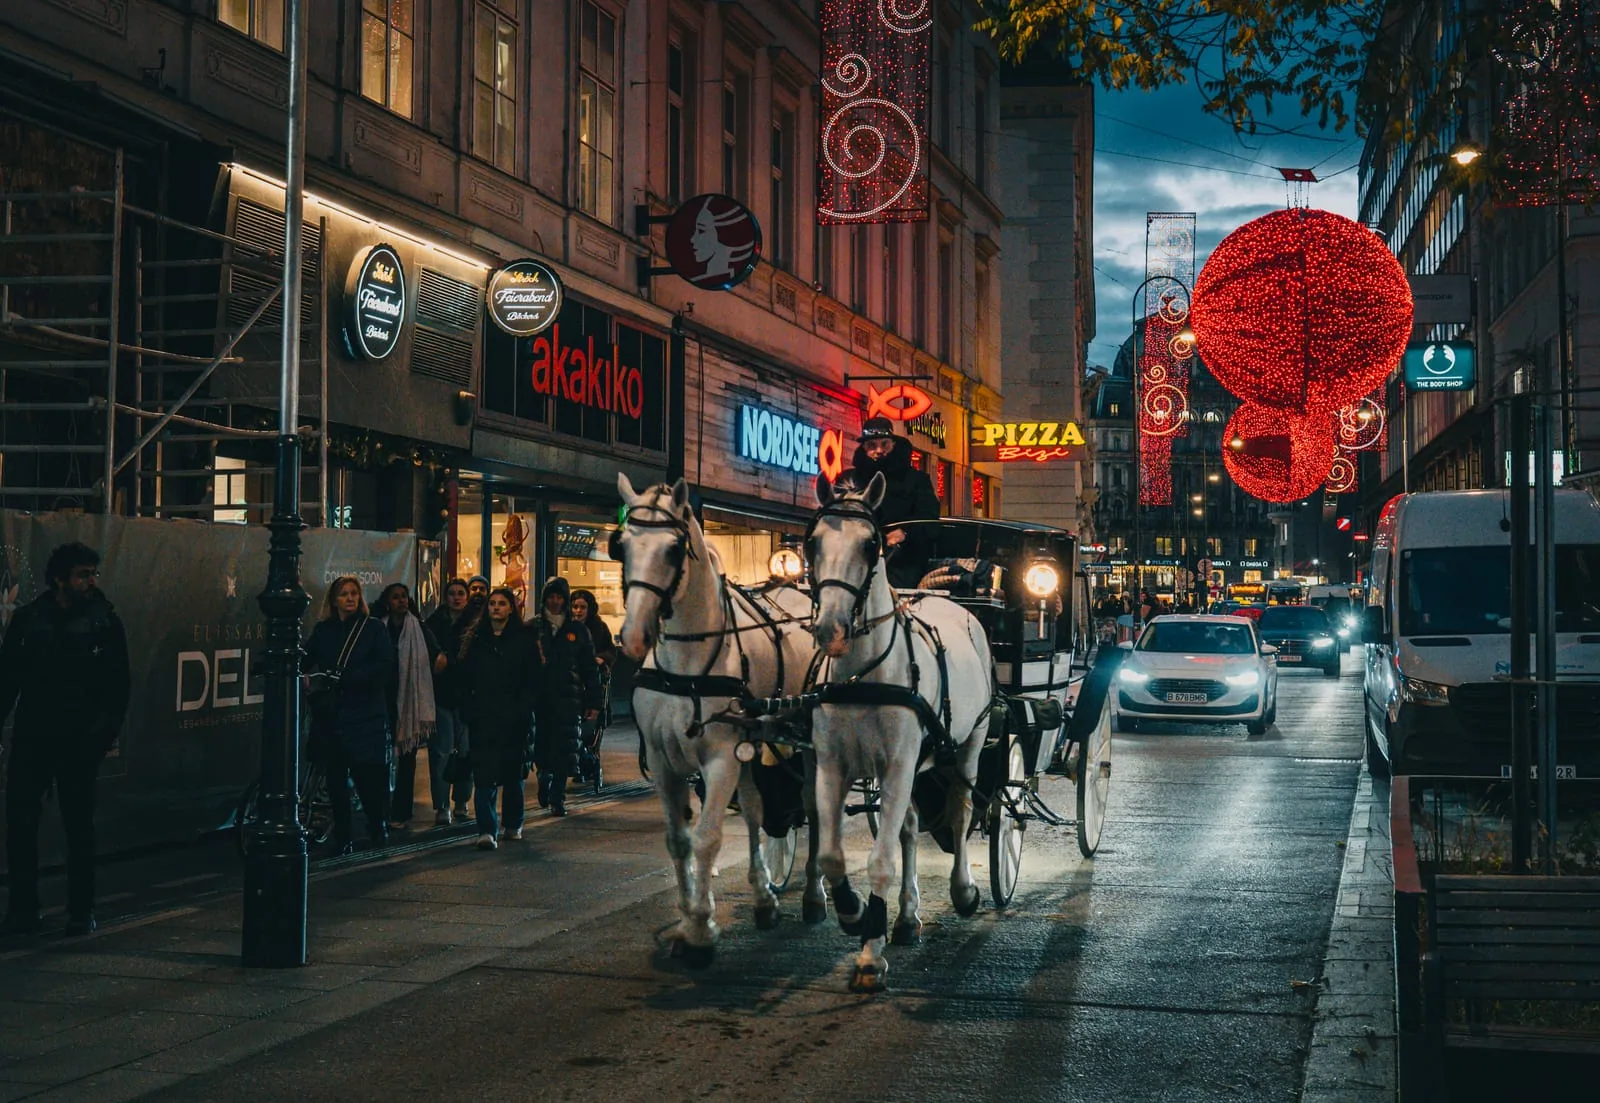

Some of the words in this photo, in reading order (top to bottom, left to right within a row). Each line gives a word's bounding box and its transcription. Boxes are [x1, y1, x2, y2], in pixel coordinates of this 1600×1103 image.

[495, 290, 555, 304] Feierabend
[532, 322, 643, 420] akakiko
[1416, 380, 1429, 388] THE
[1430, 380, 1446, 388] BODY
[1446, 380, 1463, 388] SHOP
[742, 404, 819, 475] NORDSEE
[983, 422, 1086, 446] PIZZA
[358, 571, 382, 584] SOON
[176, 648, 264, 712] DEL
